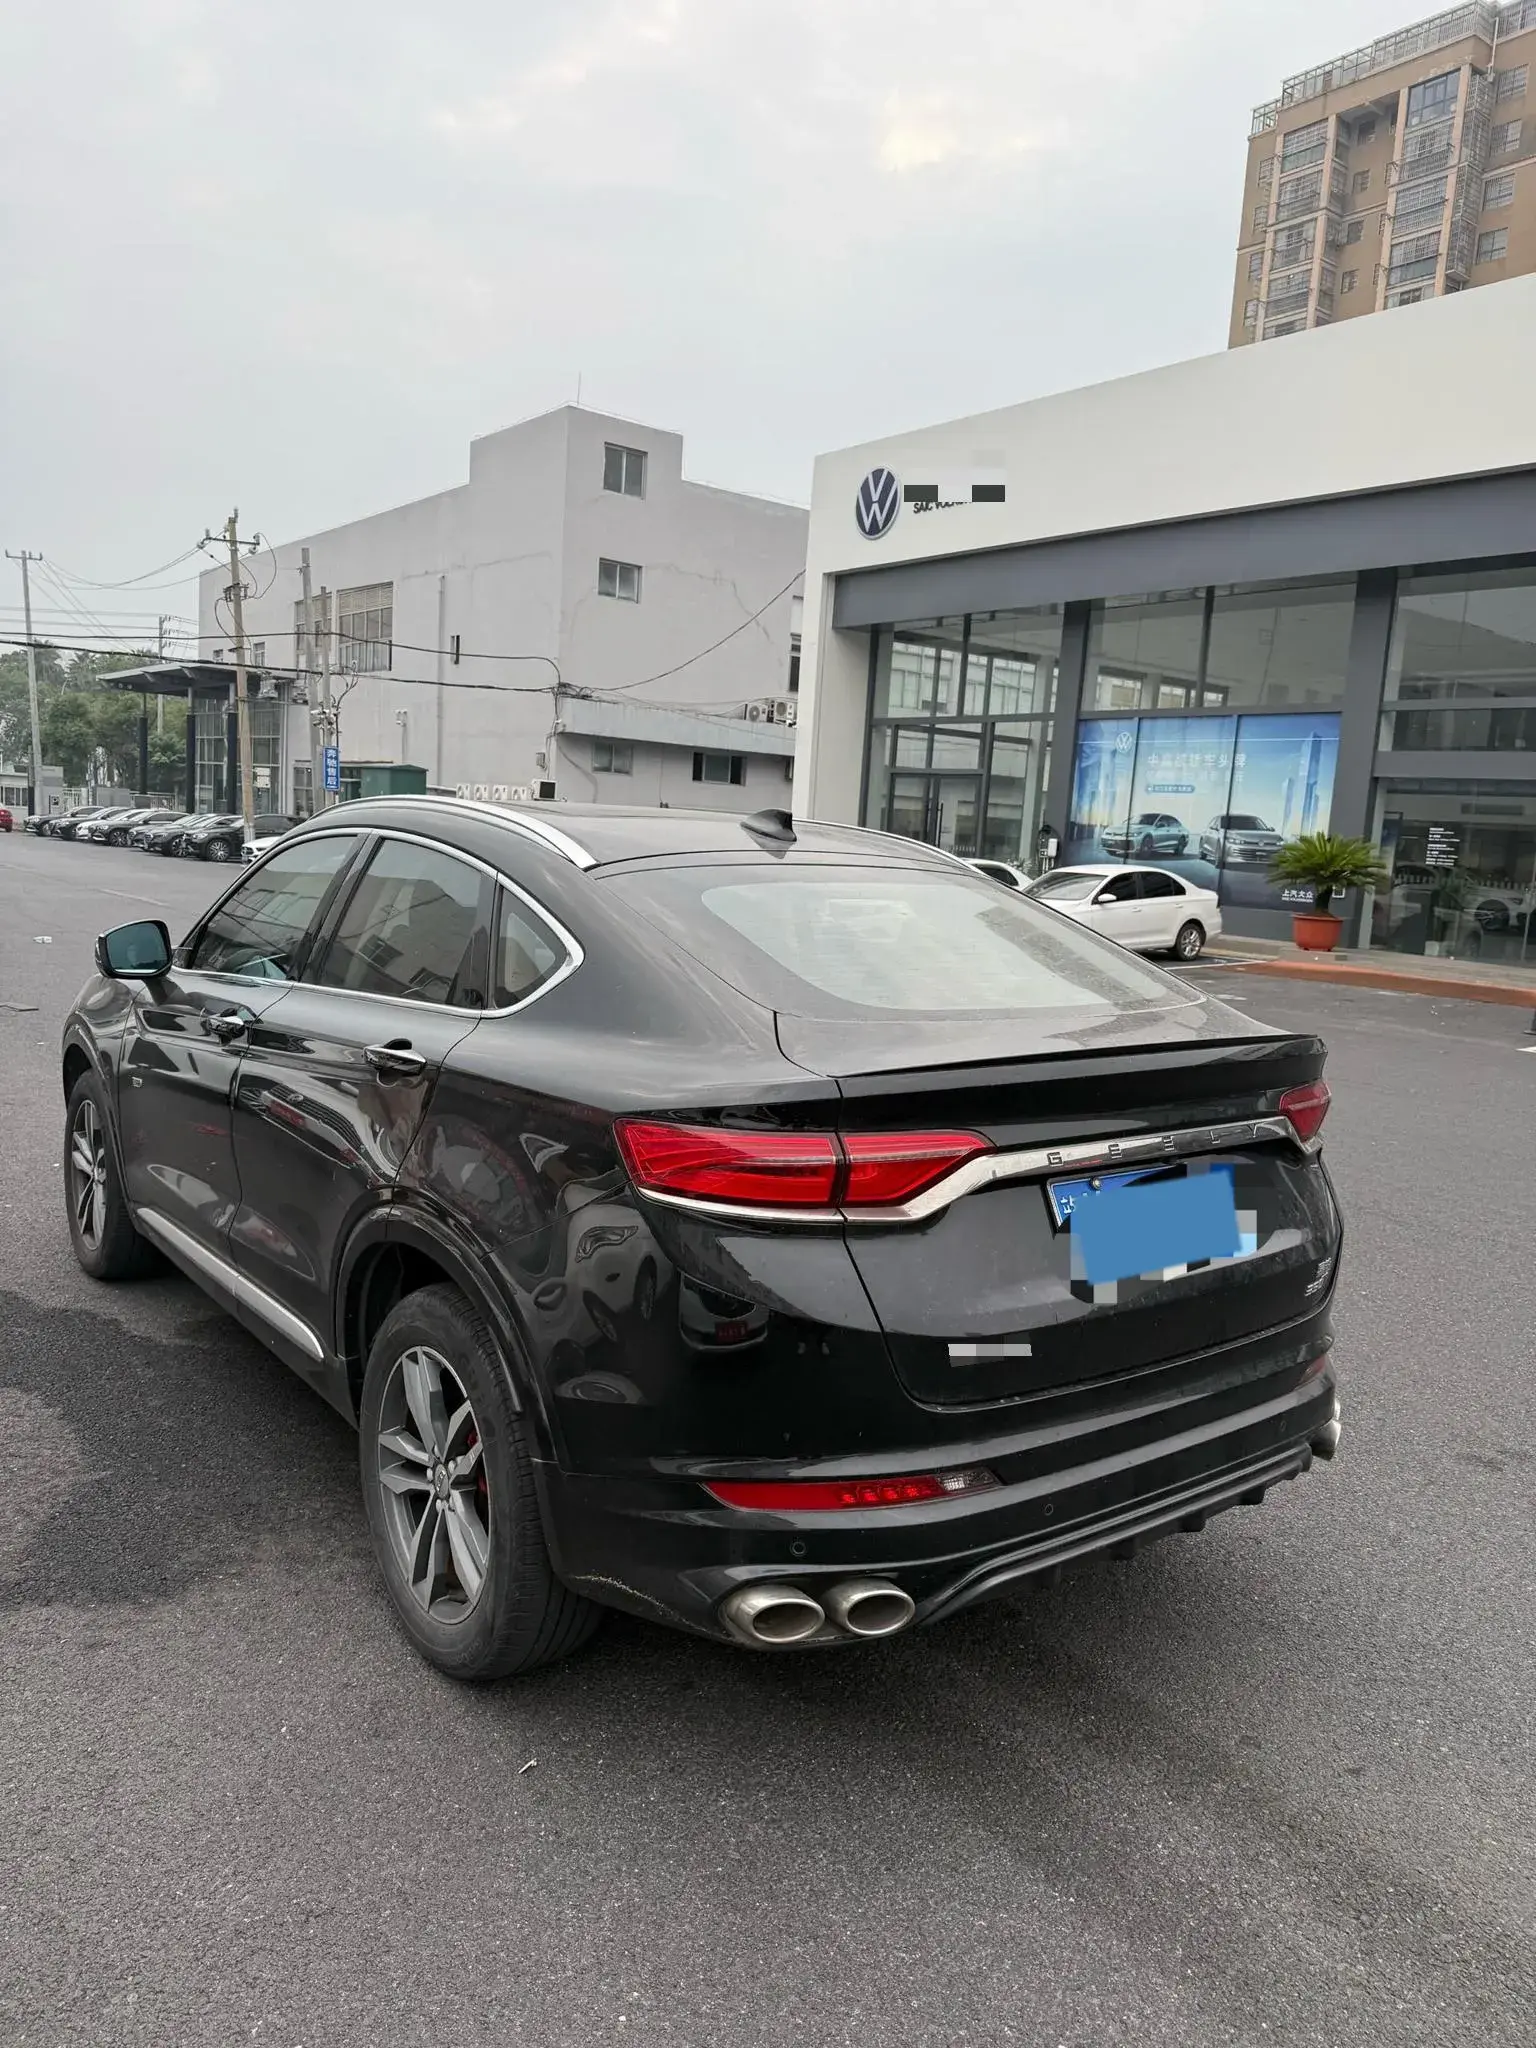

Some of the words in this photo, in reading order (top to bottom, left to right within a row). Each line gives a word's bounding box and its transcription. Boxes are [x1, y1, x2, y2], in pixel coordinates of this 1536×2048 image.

[857, 467, 899, 535] VW
[326, 749, 337, 785] 奔驰售后
[1282, 888, 1313, 898] 上汽大众
[1047, 1123, 1259, 1166] GEELY
